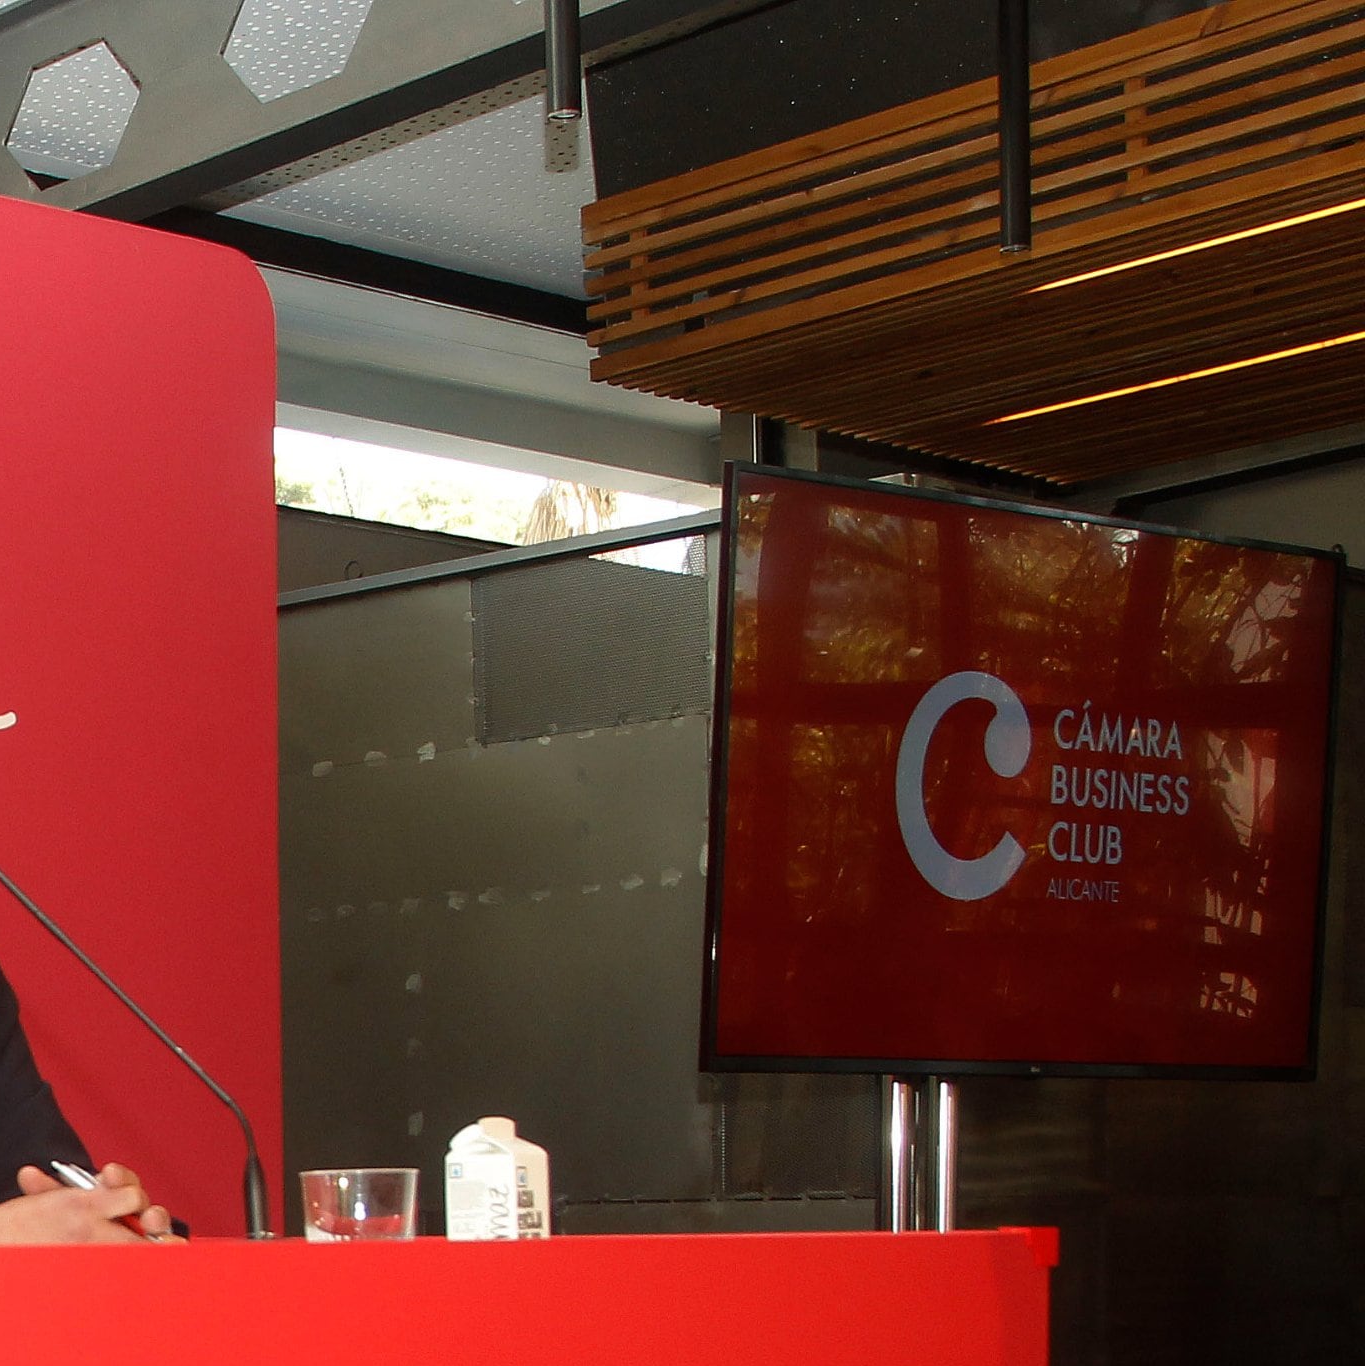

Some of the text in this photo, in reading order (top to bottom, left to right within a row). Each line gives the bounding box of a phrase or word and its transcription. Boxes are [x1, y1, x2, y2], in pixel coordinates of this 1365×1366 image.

[1053, 699, 1183, 761] CÁMARA
[1050, 764, 1190, 816] BUSINESS
[1047, 820, 1123, 866] CLUB
[1045, 877, 1121, 903] ALICANTE
